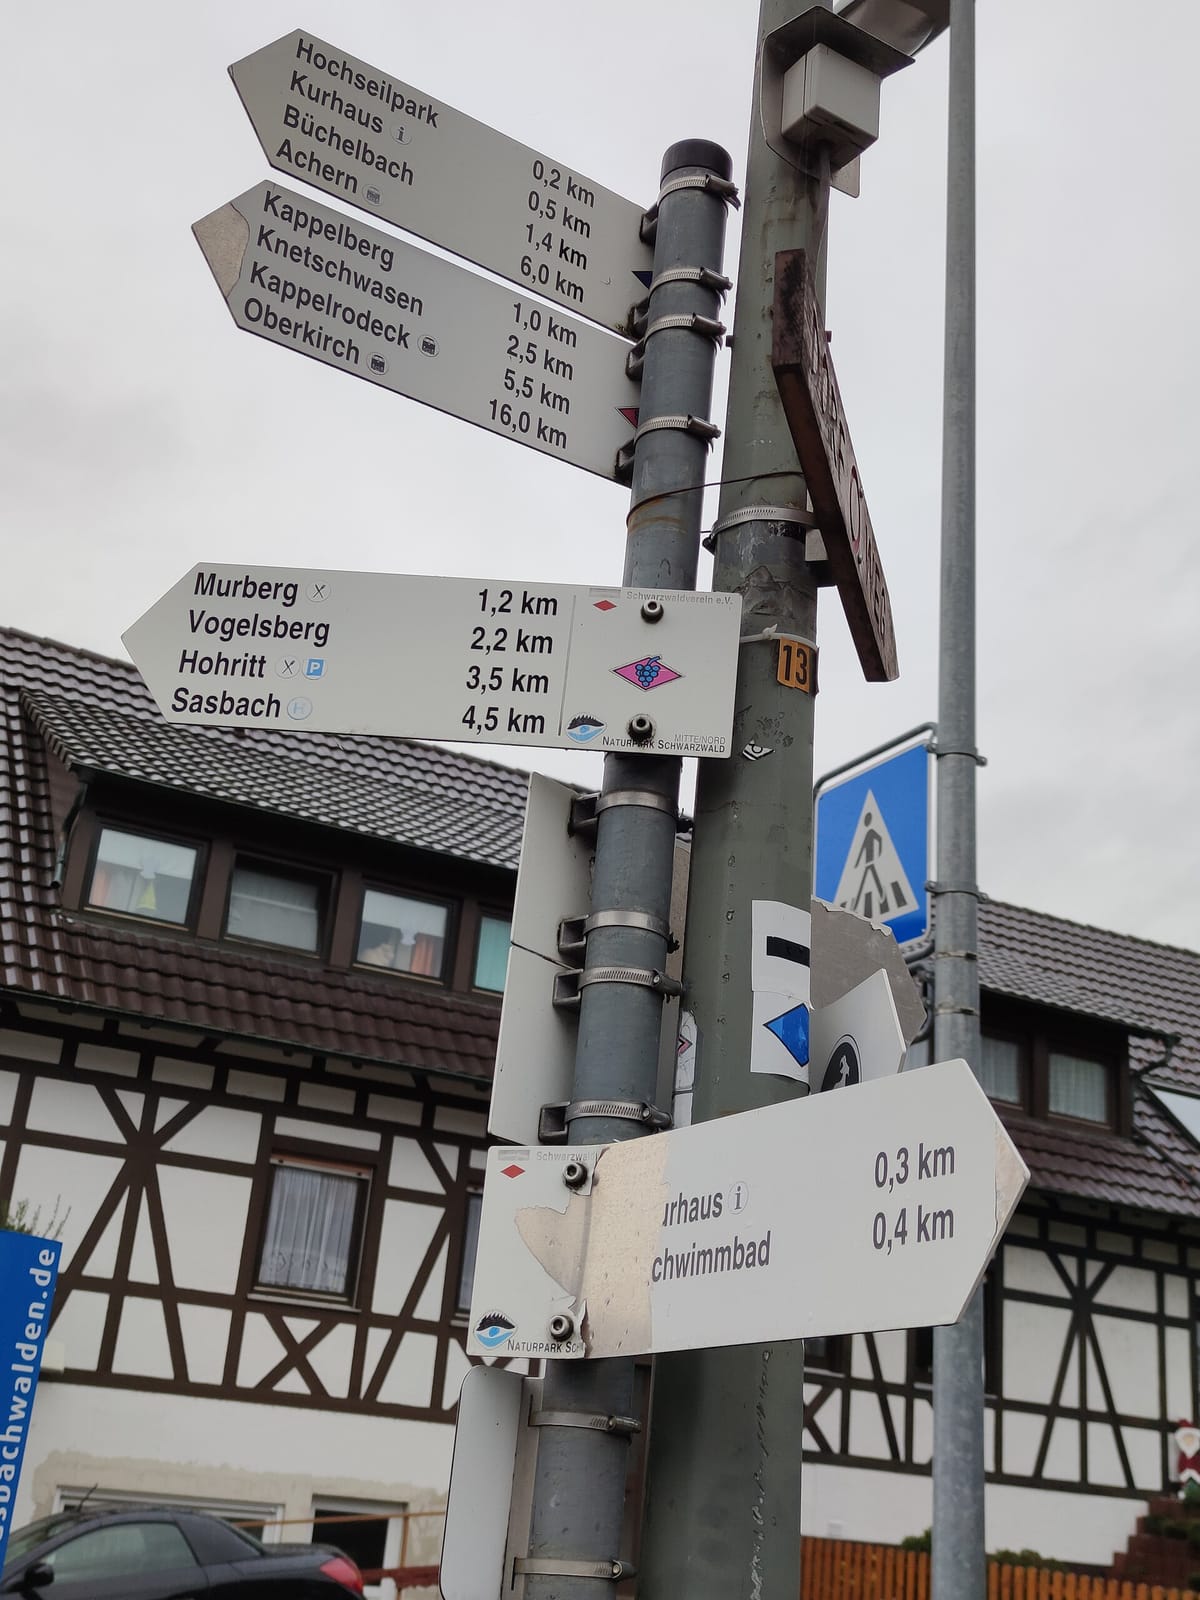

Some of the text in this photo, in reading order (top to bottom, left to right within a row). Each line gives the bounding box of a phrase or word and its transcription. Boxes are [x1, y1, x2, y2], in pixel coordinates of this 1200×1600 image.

[290, 70, 384, 134] Kurhaus
[296, 38, 439, 128] Hochseilpark
[276, 139, 358, 193] Achern
[283, 104, 414, 186] Büchelbach
[532, 159, 595, 207] 0,2 km
[263, 190, 394, 273] Kappelberg
[528, 190, 591, 239] 0,5 km
[525, 223, 588, 270] 1,4 km
[256, 225, 423, 316] Knetschwasen
[520, 256, 585, 303] 6,0 km
[250, 262, 410, 349] Kappelrodeck
[512, 302, 577, 348] 1,0 km
[244, 297, 360, 364] Oberkirch
[507, 334, 574, 381] 2,5 km
[504, 369, 570, 415] 5,5 km
[488, 399, 567, 449] 16,0 km
[194, 572, 298, 607] Murberg
[478, 588, 558, 617] 1,2 km
[626, 591, 733, 605] Schwarzwaldverein e.V.
[188, 610, 330, 647] Vogelsberg
[470, 626, 553, 655] 2,2 km
[178, 650, 266, 678] Hohritt
[466, 665, 549, 695] 3,5 km
[783, 645, 808, 685] 13
[171, 687, 281, 718] Sasbach
[462, 705, 545, 735] 4,5 km
[657, 740, 725, 753] SCHWARZWALD
[874, 1143, 955, 1193] 0,3 km
[873, 1205, 954, 1255] 0,4 km
[507, 1339, 562, 1353] NATURPARK
